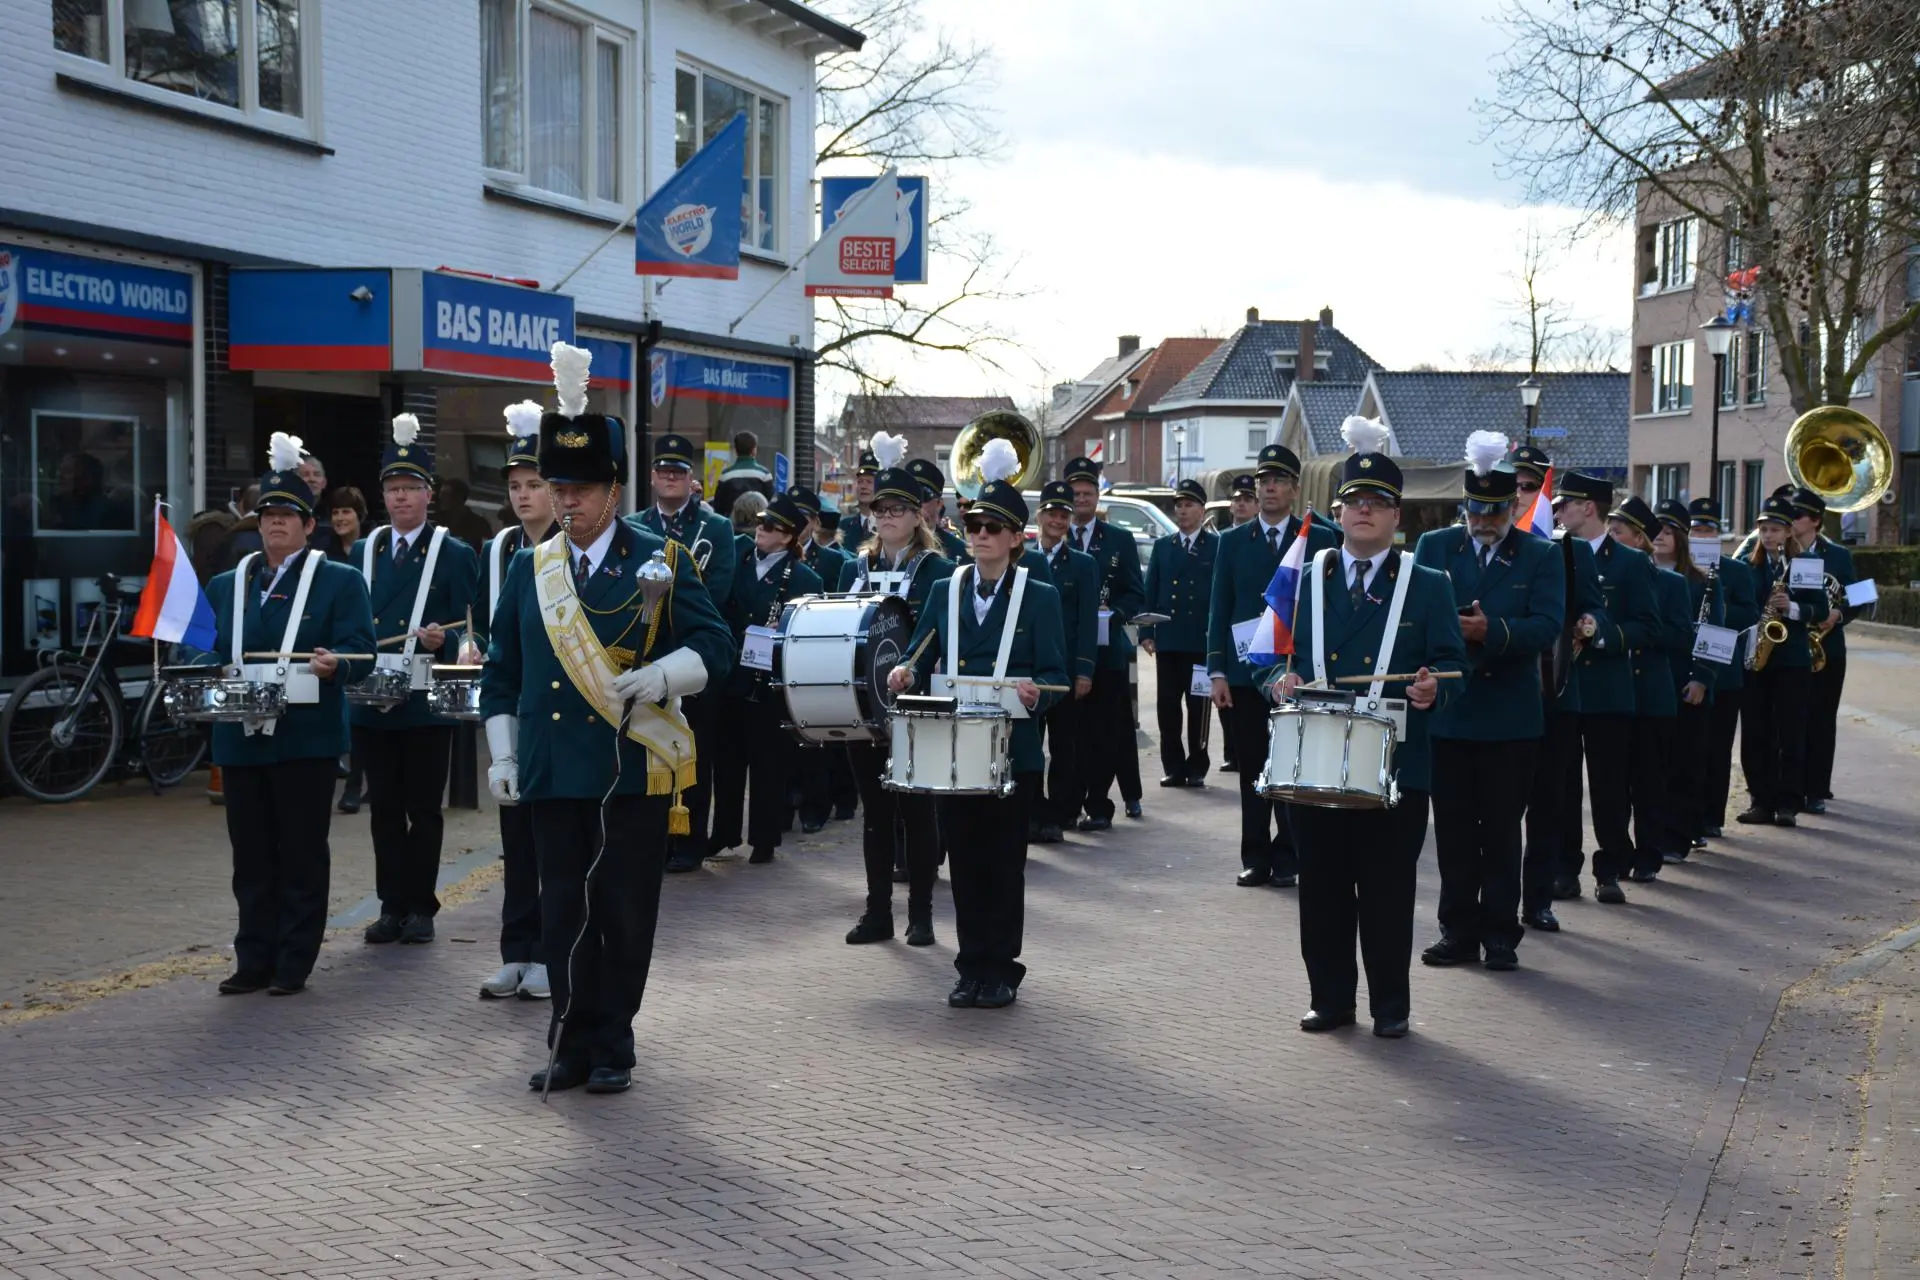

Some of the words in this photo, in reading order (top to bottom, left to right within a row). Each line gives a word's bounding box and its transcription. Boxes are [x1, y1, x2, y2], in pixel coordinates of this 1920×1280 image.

[667, 206, 705, 224] ELECTRO
[669, 217, 704, 237] WORLD
[843, 241, 891, 258] BESTE
[842, 258, 891, 271] SELECTIE
[26, 267, 115, 305] ELECTRO
[120, 281, 188, 314] WORLD
[437, 300, 482, 343] BAS
[703, 367, 720, 387] BAS
